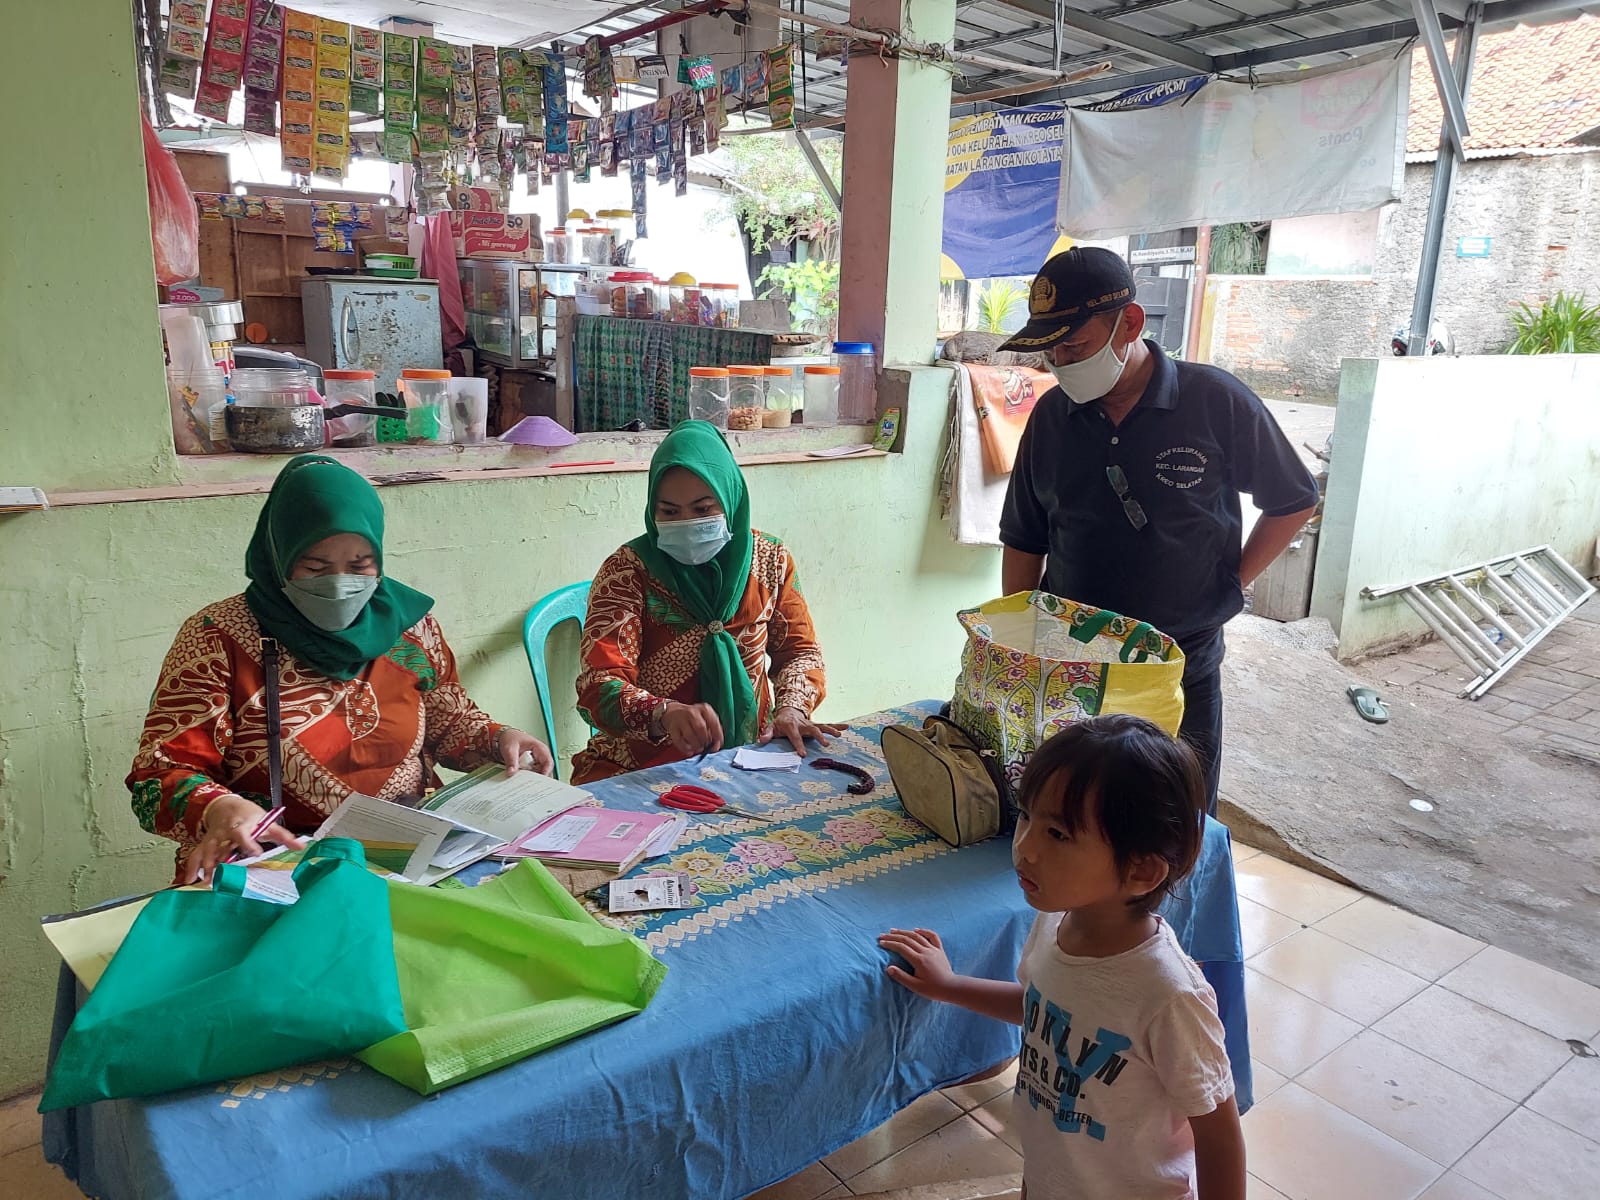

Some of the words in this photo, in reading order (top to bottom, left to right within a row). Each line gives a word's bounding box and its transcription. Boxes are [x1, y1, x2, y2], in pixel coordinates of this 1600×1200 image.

[966, 114, 1024, 135] PEMBATASAN
[951, 144, 967, 156] 004
[968, 133, 1023, 152] KELURAHAN
[1024, 127, 1046, 145] KREO
[970, 152, 1024, 171] LARANGAN
[1024, 149, 1049, 164] KOTA
[1173, 464, 1205, 473] LARANGAN
[1176, 476, 1203, 489] SELATAN
